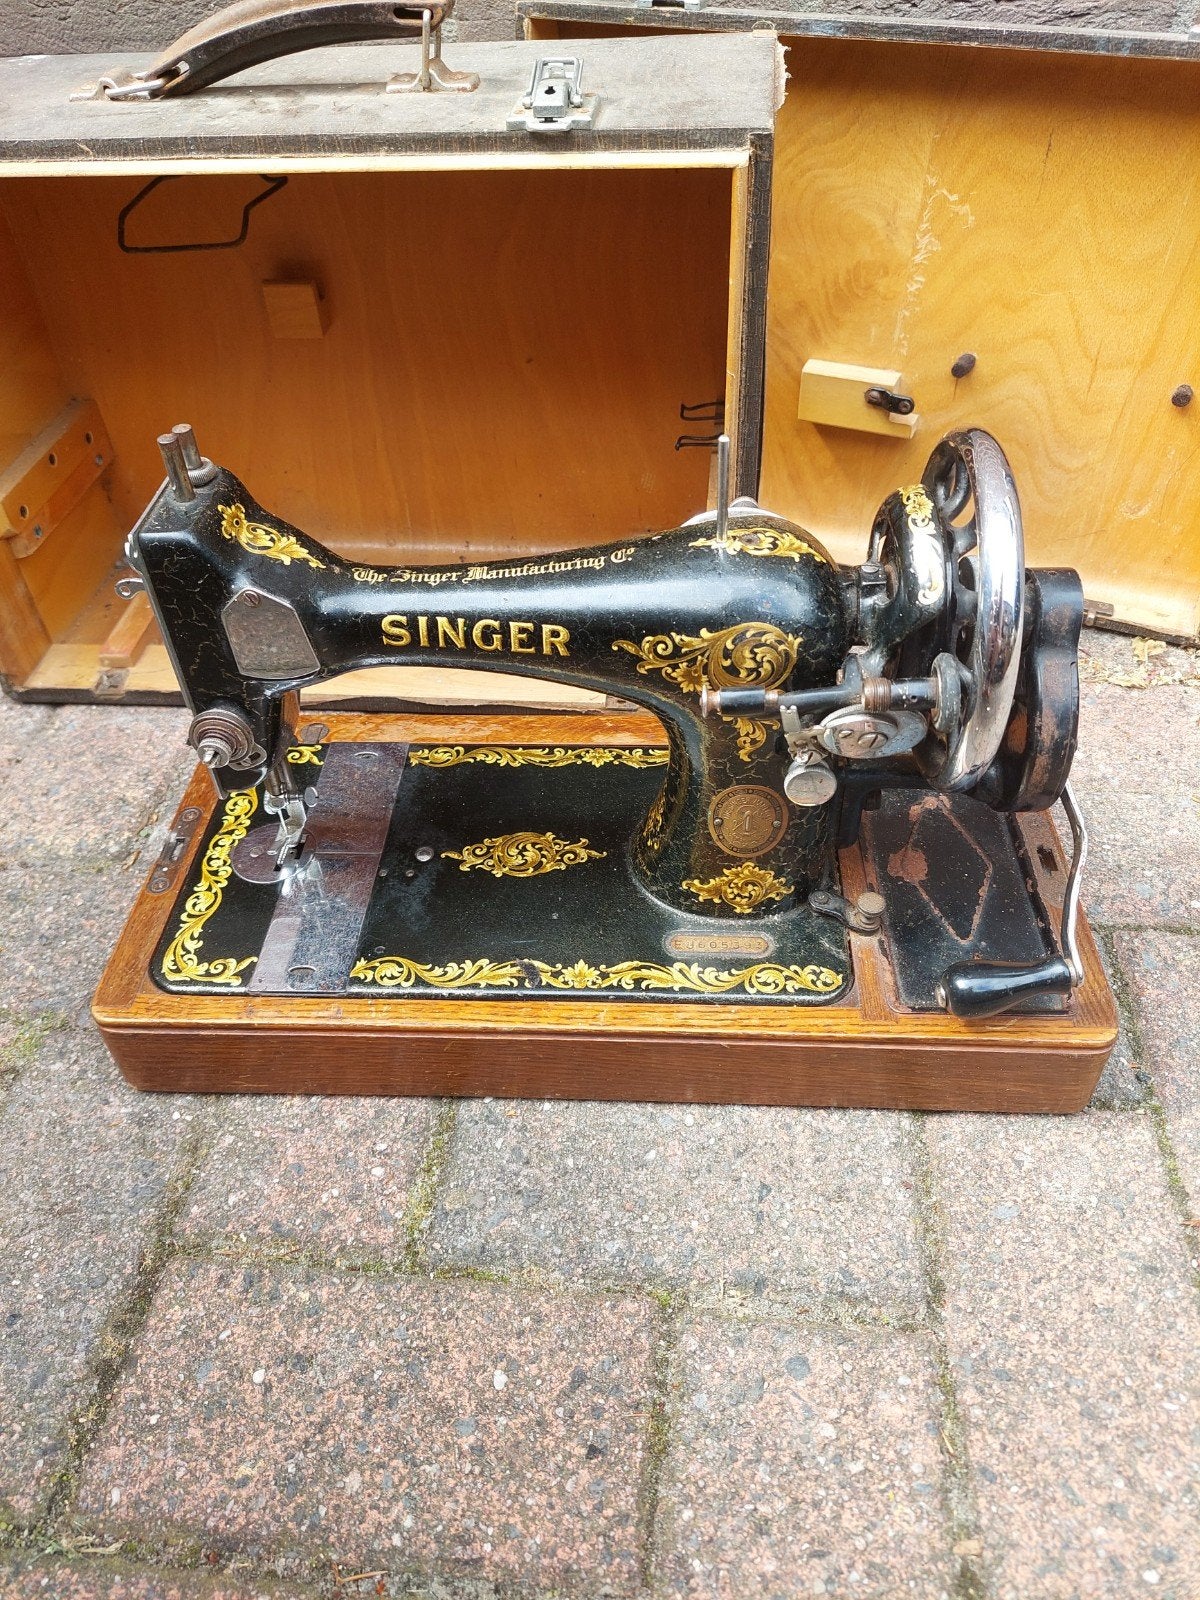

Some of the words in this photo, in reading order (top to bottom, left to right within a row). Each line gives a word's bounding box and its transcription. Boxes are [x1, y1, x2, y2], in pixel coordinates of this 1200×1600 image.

[352, 567, 387, 584] The
[391, 569, 462, 586] Singer
[462, 555, 605, 583] Manufacturing
[381, 614, 571, 656] SINGER
